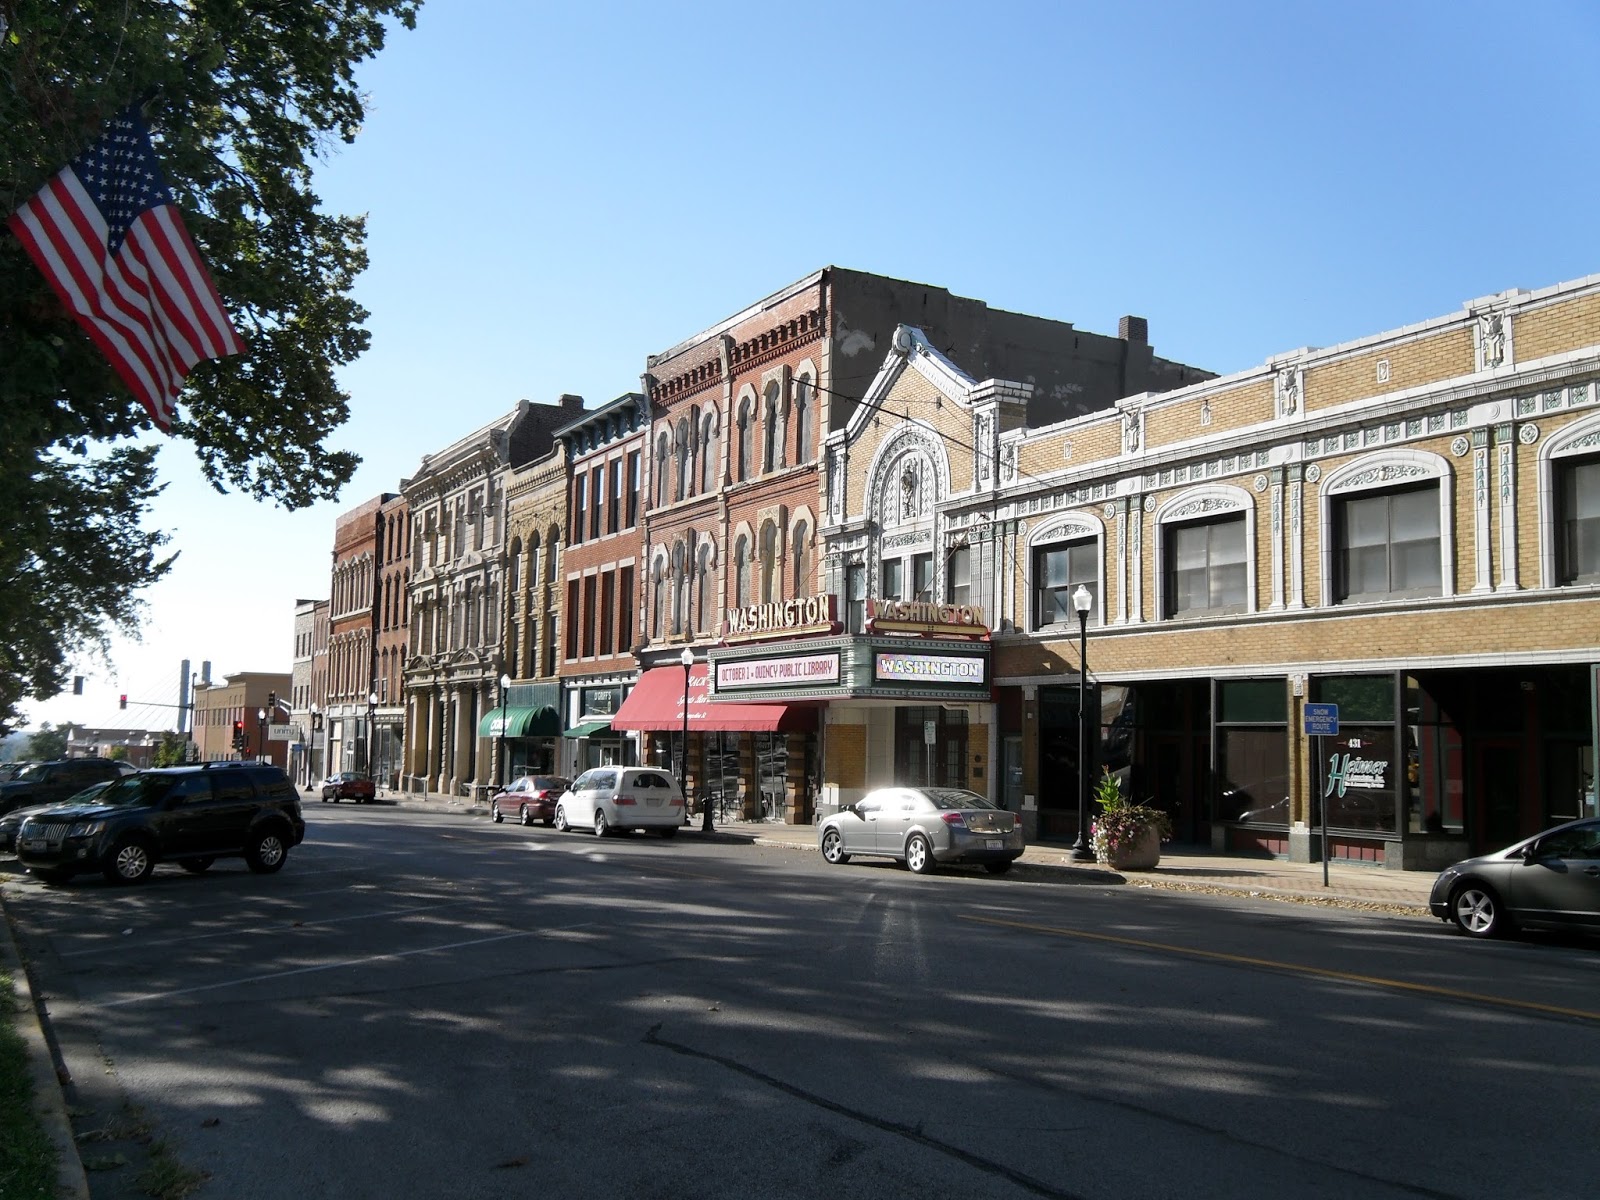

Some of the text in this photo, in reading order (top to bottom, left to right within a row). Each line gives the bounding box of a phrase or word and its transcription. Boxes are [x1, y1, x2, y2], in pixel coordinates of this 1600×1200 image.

[728, 593, 829, 634] WASHINGTON
[873, 600, 984, 625] WASHINGTON
[721, 666, 745, 681] OCTOBER
[746, 667, 750, 679] 1
[755, 664, 778, 679] QUINCY
[779, 662, 802, 677] PUBLIC
[803, 660, 833, 676] LIBRARY
[881, 659, 979, 677] WASHINGTON
[1305, 715, 1337, 723] EMERGENCY
[1312, 723, 1331, 731] ROUTE
[1348, 738, 1361, 749] 431
[1325, 753, 1388, 798] Heimer
